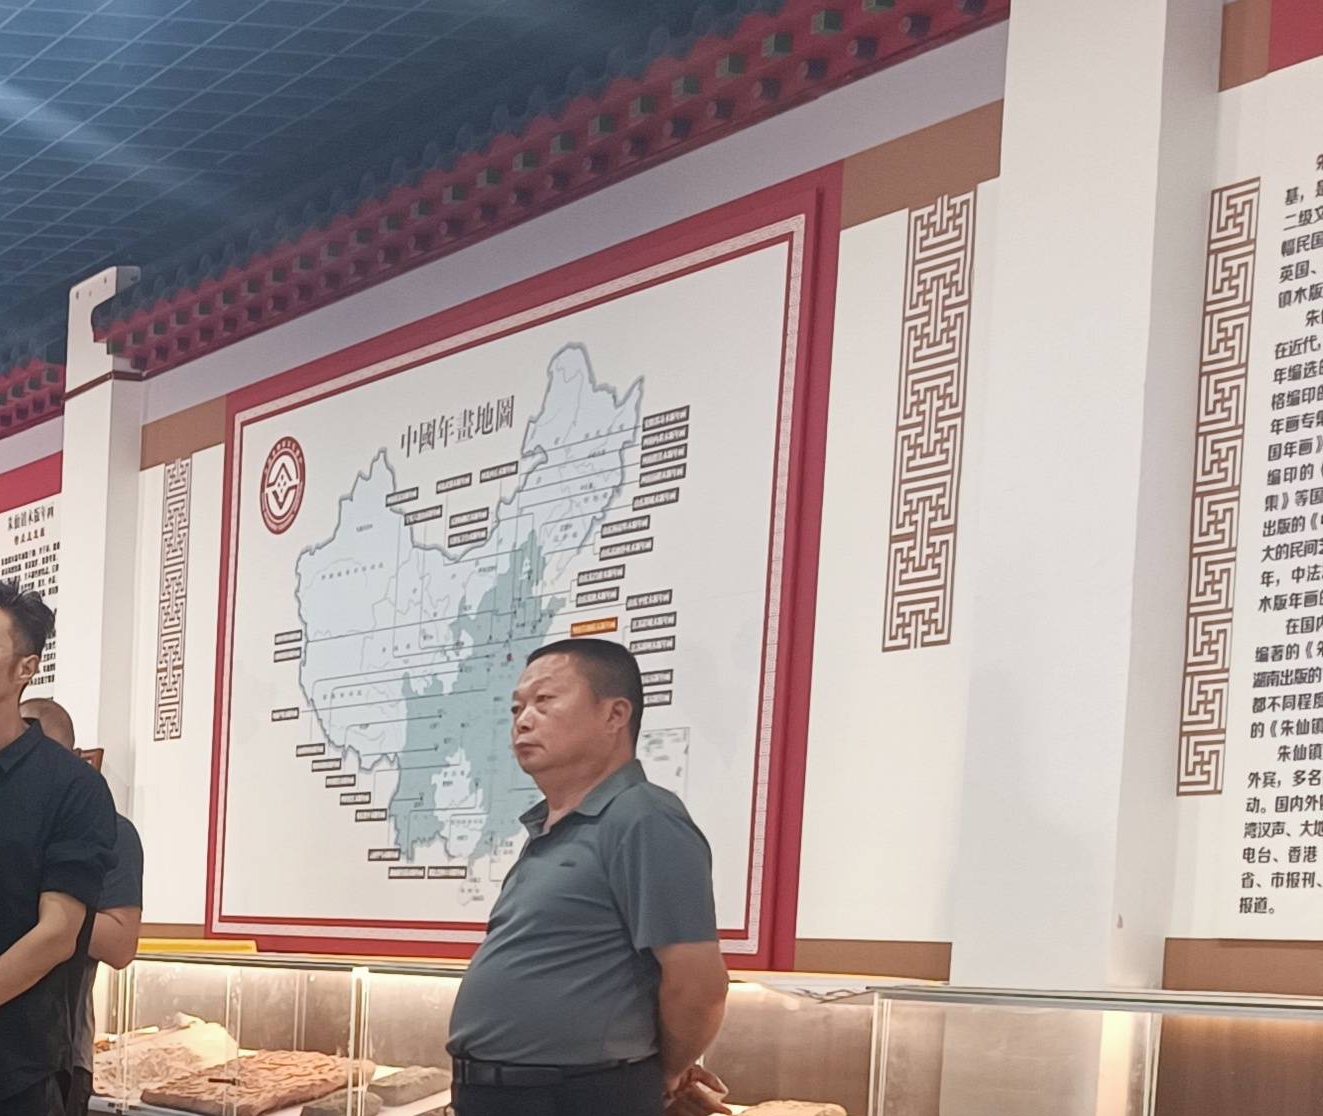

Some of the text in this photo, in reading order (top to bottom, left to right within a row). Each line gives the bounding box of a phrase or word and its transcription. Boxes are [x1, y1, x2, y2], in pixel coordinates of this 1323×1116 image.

[1306, 309, 1323, 327] 朱
[1267, 463, 1323, 485] 编印的
[1263, 513, 1323, 537] 出版的《
[1253, 667, 1321, 688] 湖南出版的
[1246, 795, 1323, 813] 动。国内外
